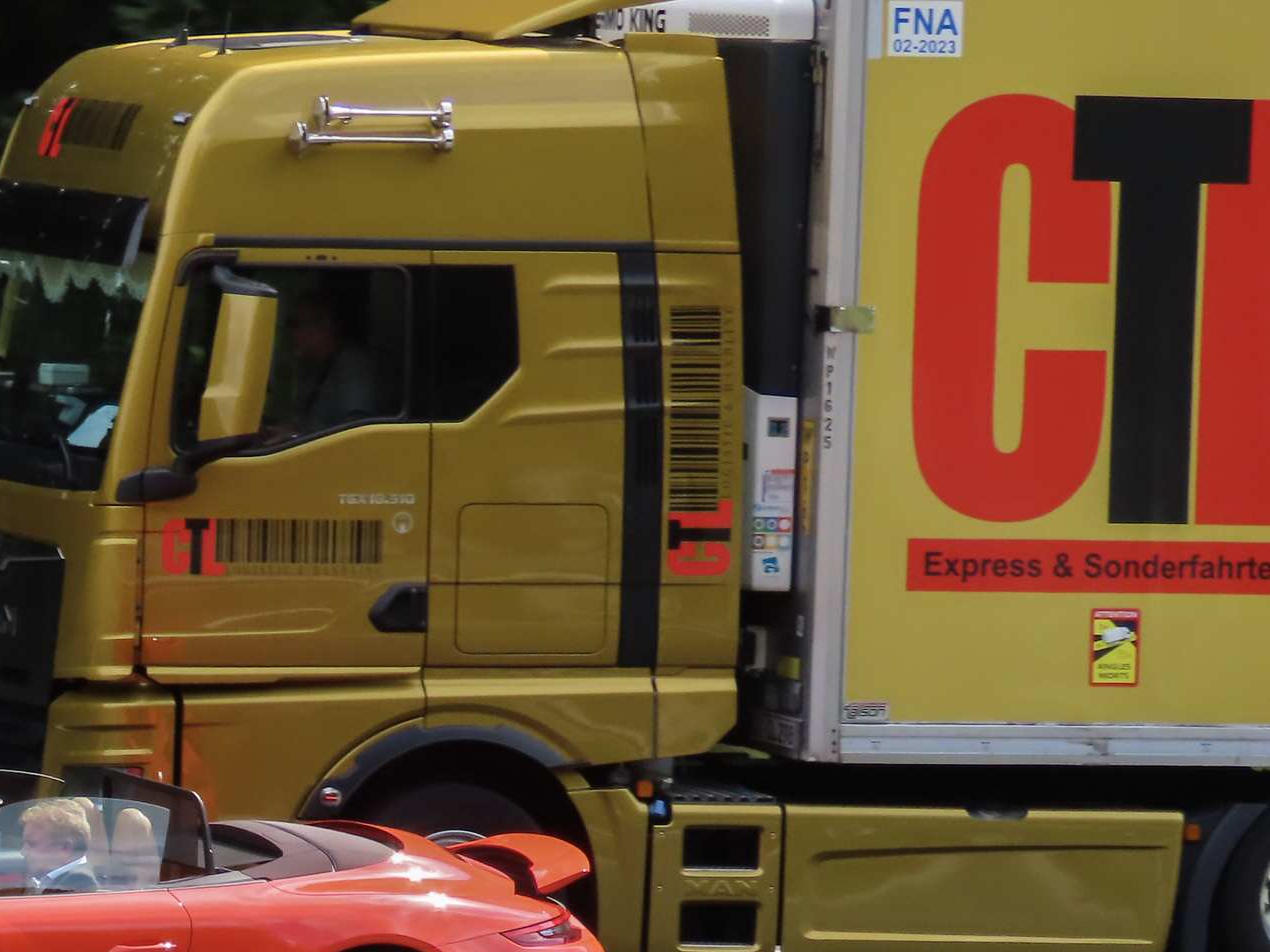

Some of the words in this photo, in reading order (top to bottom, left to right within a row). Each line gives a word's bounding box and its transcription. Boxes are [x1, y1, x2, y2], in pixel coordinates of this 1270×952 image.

[630, 8, 666, 33] KING
[894, 7, 958, 35] FNA
[893, 39, 956, 54] 02-2023
[161, 517, 226, 576] CTL
[667, 499, 734, 577] CTL
[924, 551, 1042, 583] Express
[1053, 553, 1073, 579] &
